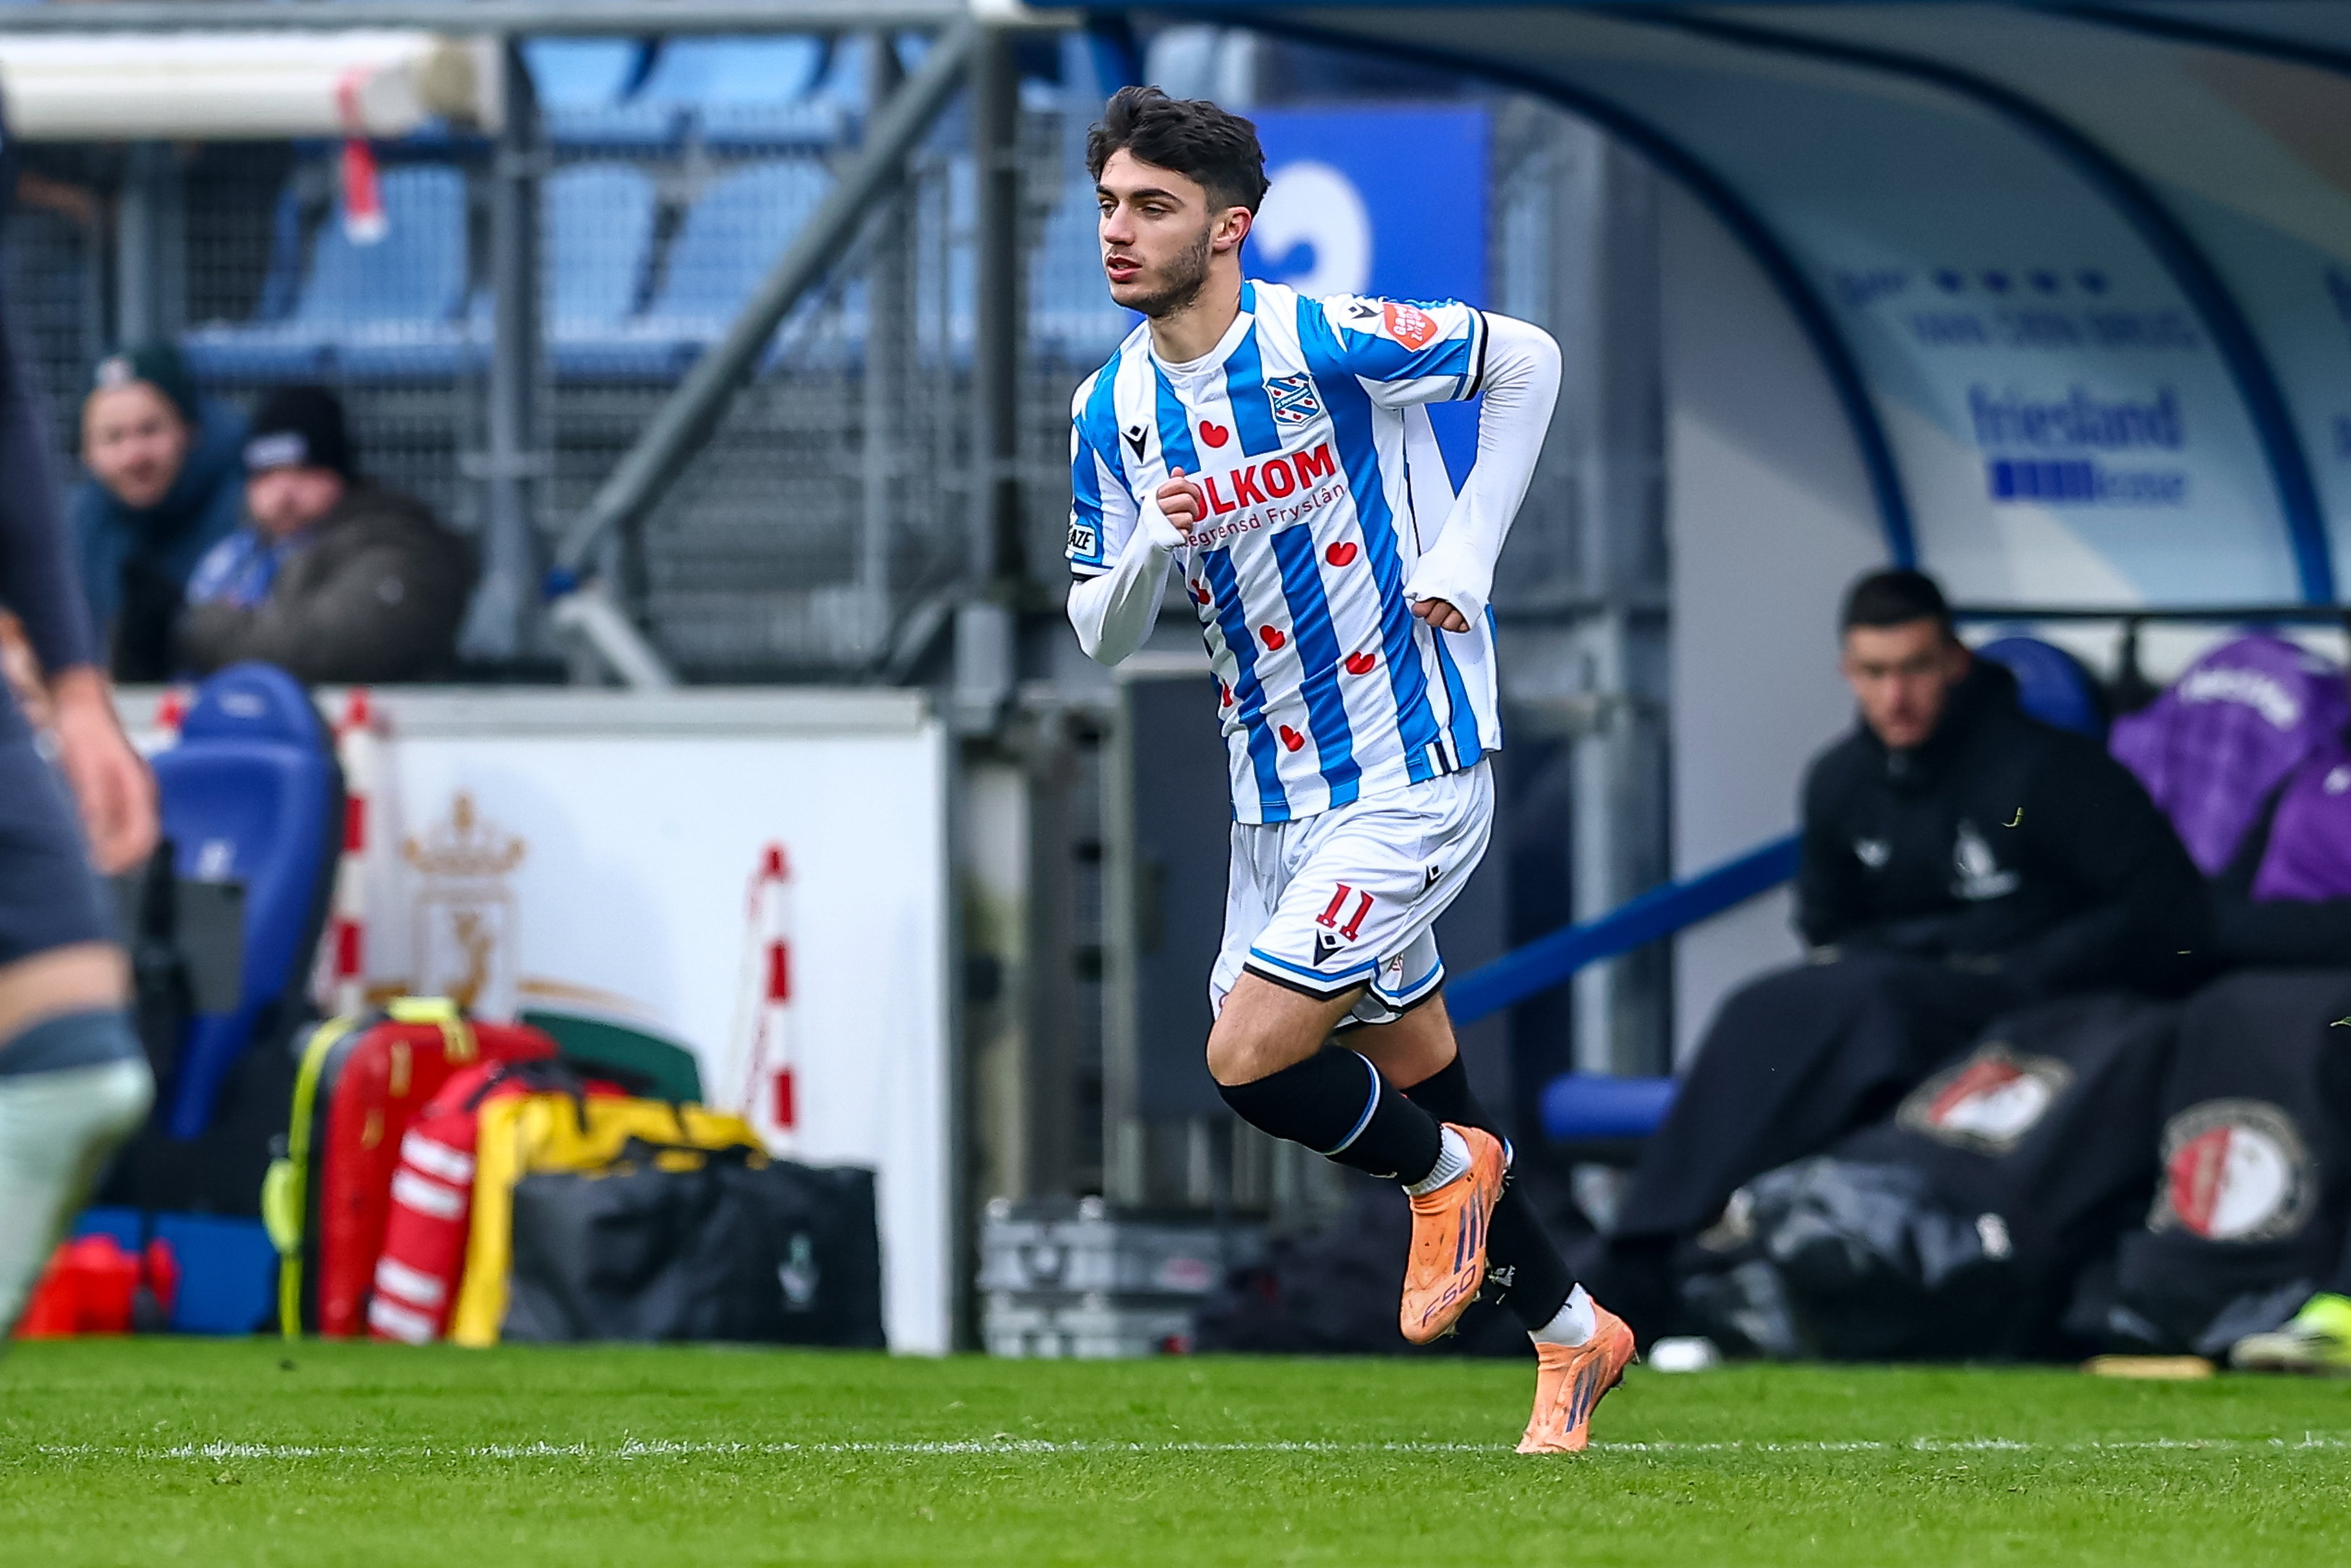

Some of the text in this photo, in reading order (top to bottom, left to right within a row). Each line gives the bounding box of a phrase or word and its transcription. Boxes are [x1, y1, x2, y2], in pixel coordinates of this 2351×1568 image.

[1192, 442, 1337, 522] LKOM
[1069, 529, 1094, 550] AZE
[1188, 484, 1345, 547] egrensd Fryslân
[1314, 882, 1374, 943] 11
[1421, 1264, 1476, 1329] F50
